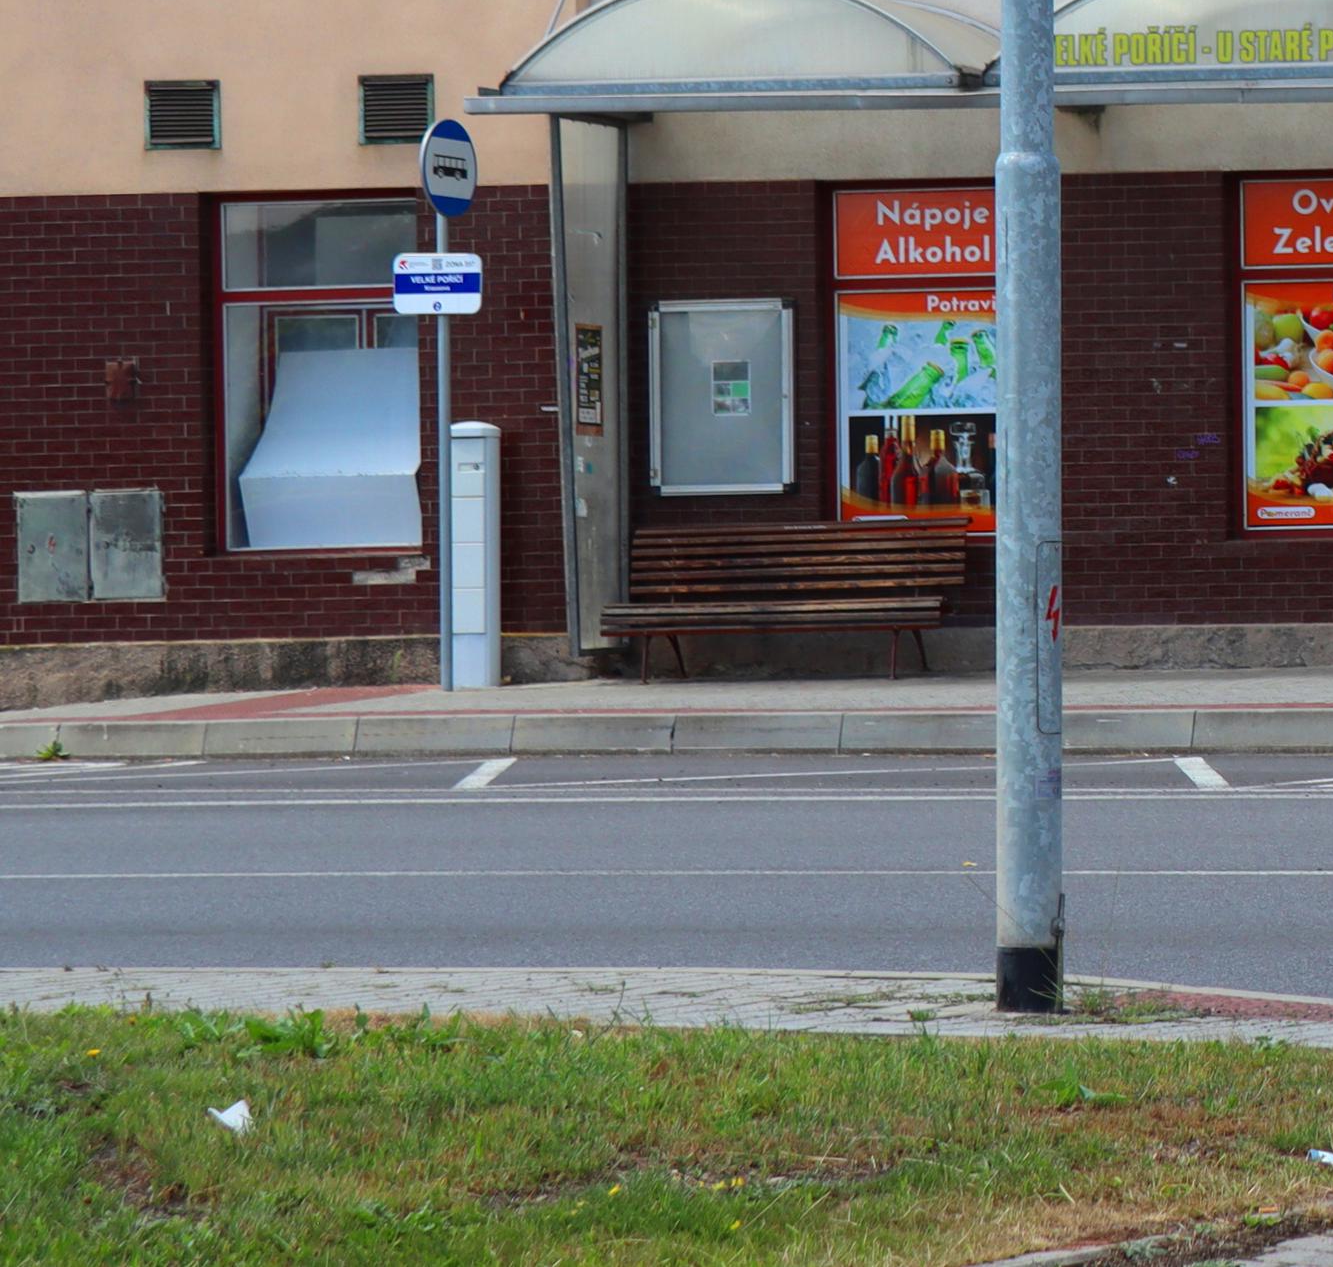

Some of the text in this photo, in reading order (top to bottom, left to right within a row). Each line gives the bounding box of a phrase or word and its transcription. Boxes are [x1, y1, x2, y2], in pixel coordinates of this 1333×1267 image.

[1054, 27, 1107, 67] ELKÉ
[1112, 24, 1198, 66] POŘÍČÍ
[1216, 31, 1234, 63] U
[1239, 22, 1313, 62] STARÉ
[876, 199, 990, 231] Nápoje
[875, 235, 991, 265] Alkohol
[927, 295, 996, 312] Potravi
